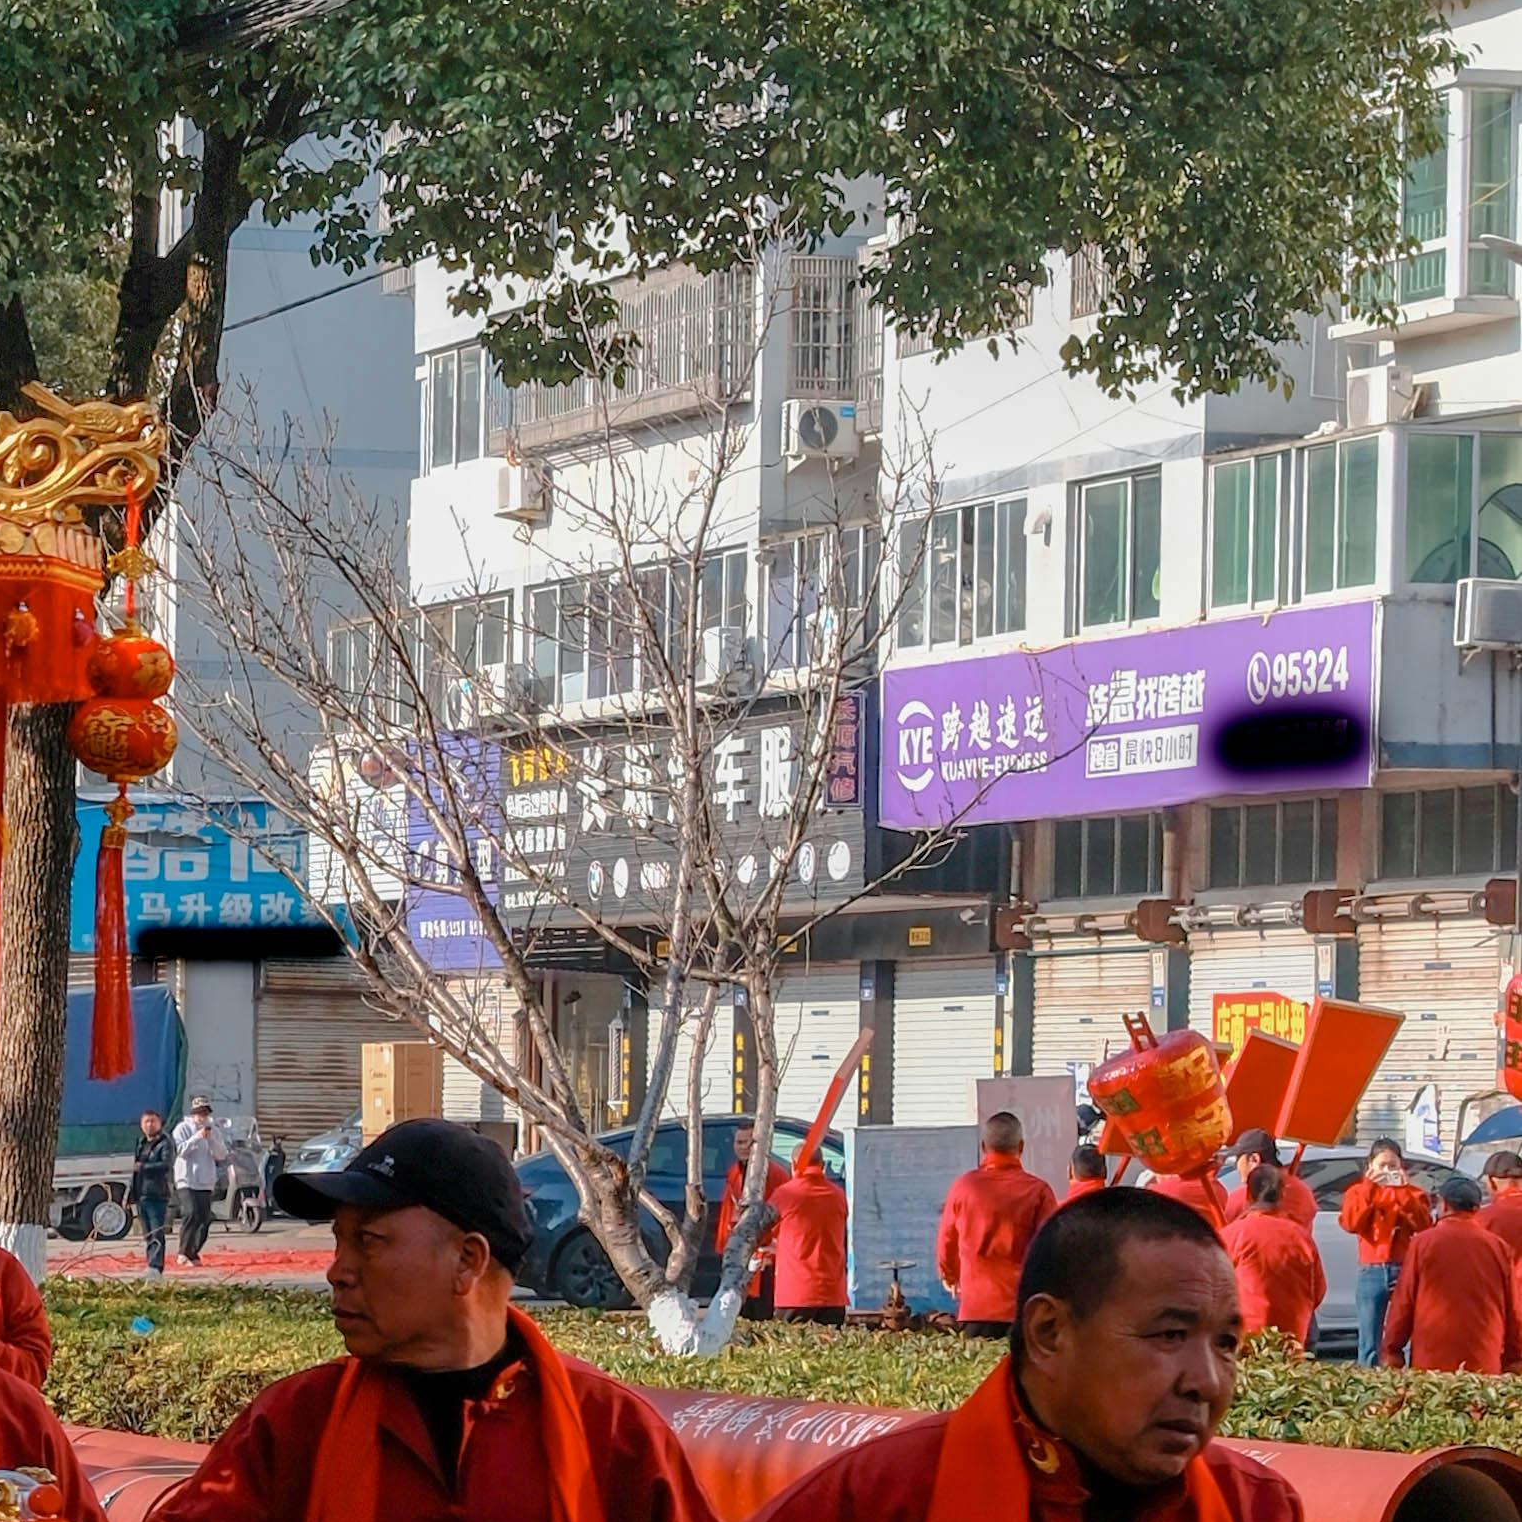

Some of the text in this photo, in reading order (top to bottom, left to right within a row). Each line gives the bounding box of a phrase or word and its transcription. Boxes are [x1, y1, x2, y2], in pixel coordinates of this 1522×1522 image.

[1272, 645, 1350, 698] 95324
[941, 694, 1048, 752] 跨越速运
[899, 726, 934, 767] KYE
[1125, 733, 1193, 767] 最快8小时
[125, 892, 327, 928] 马升级改
